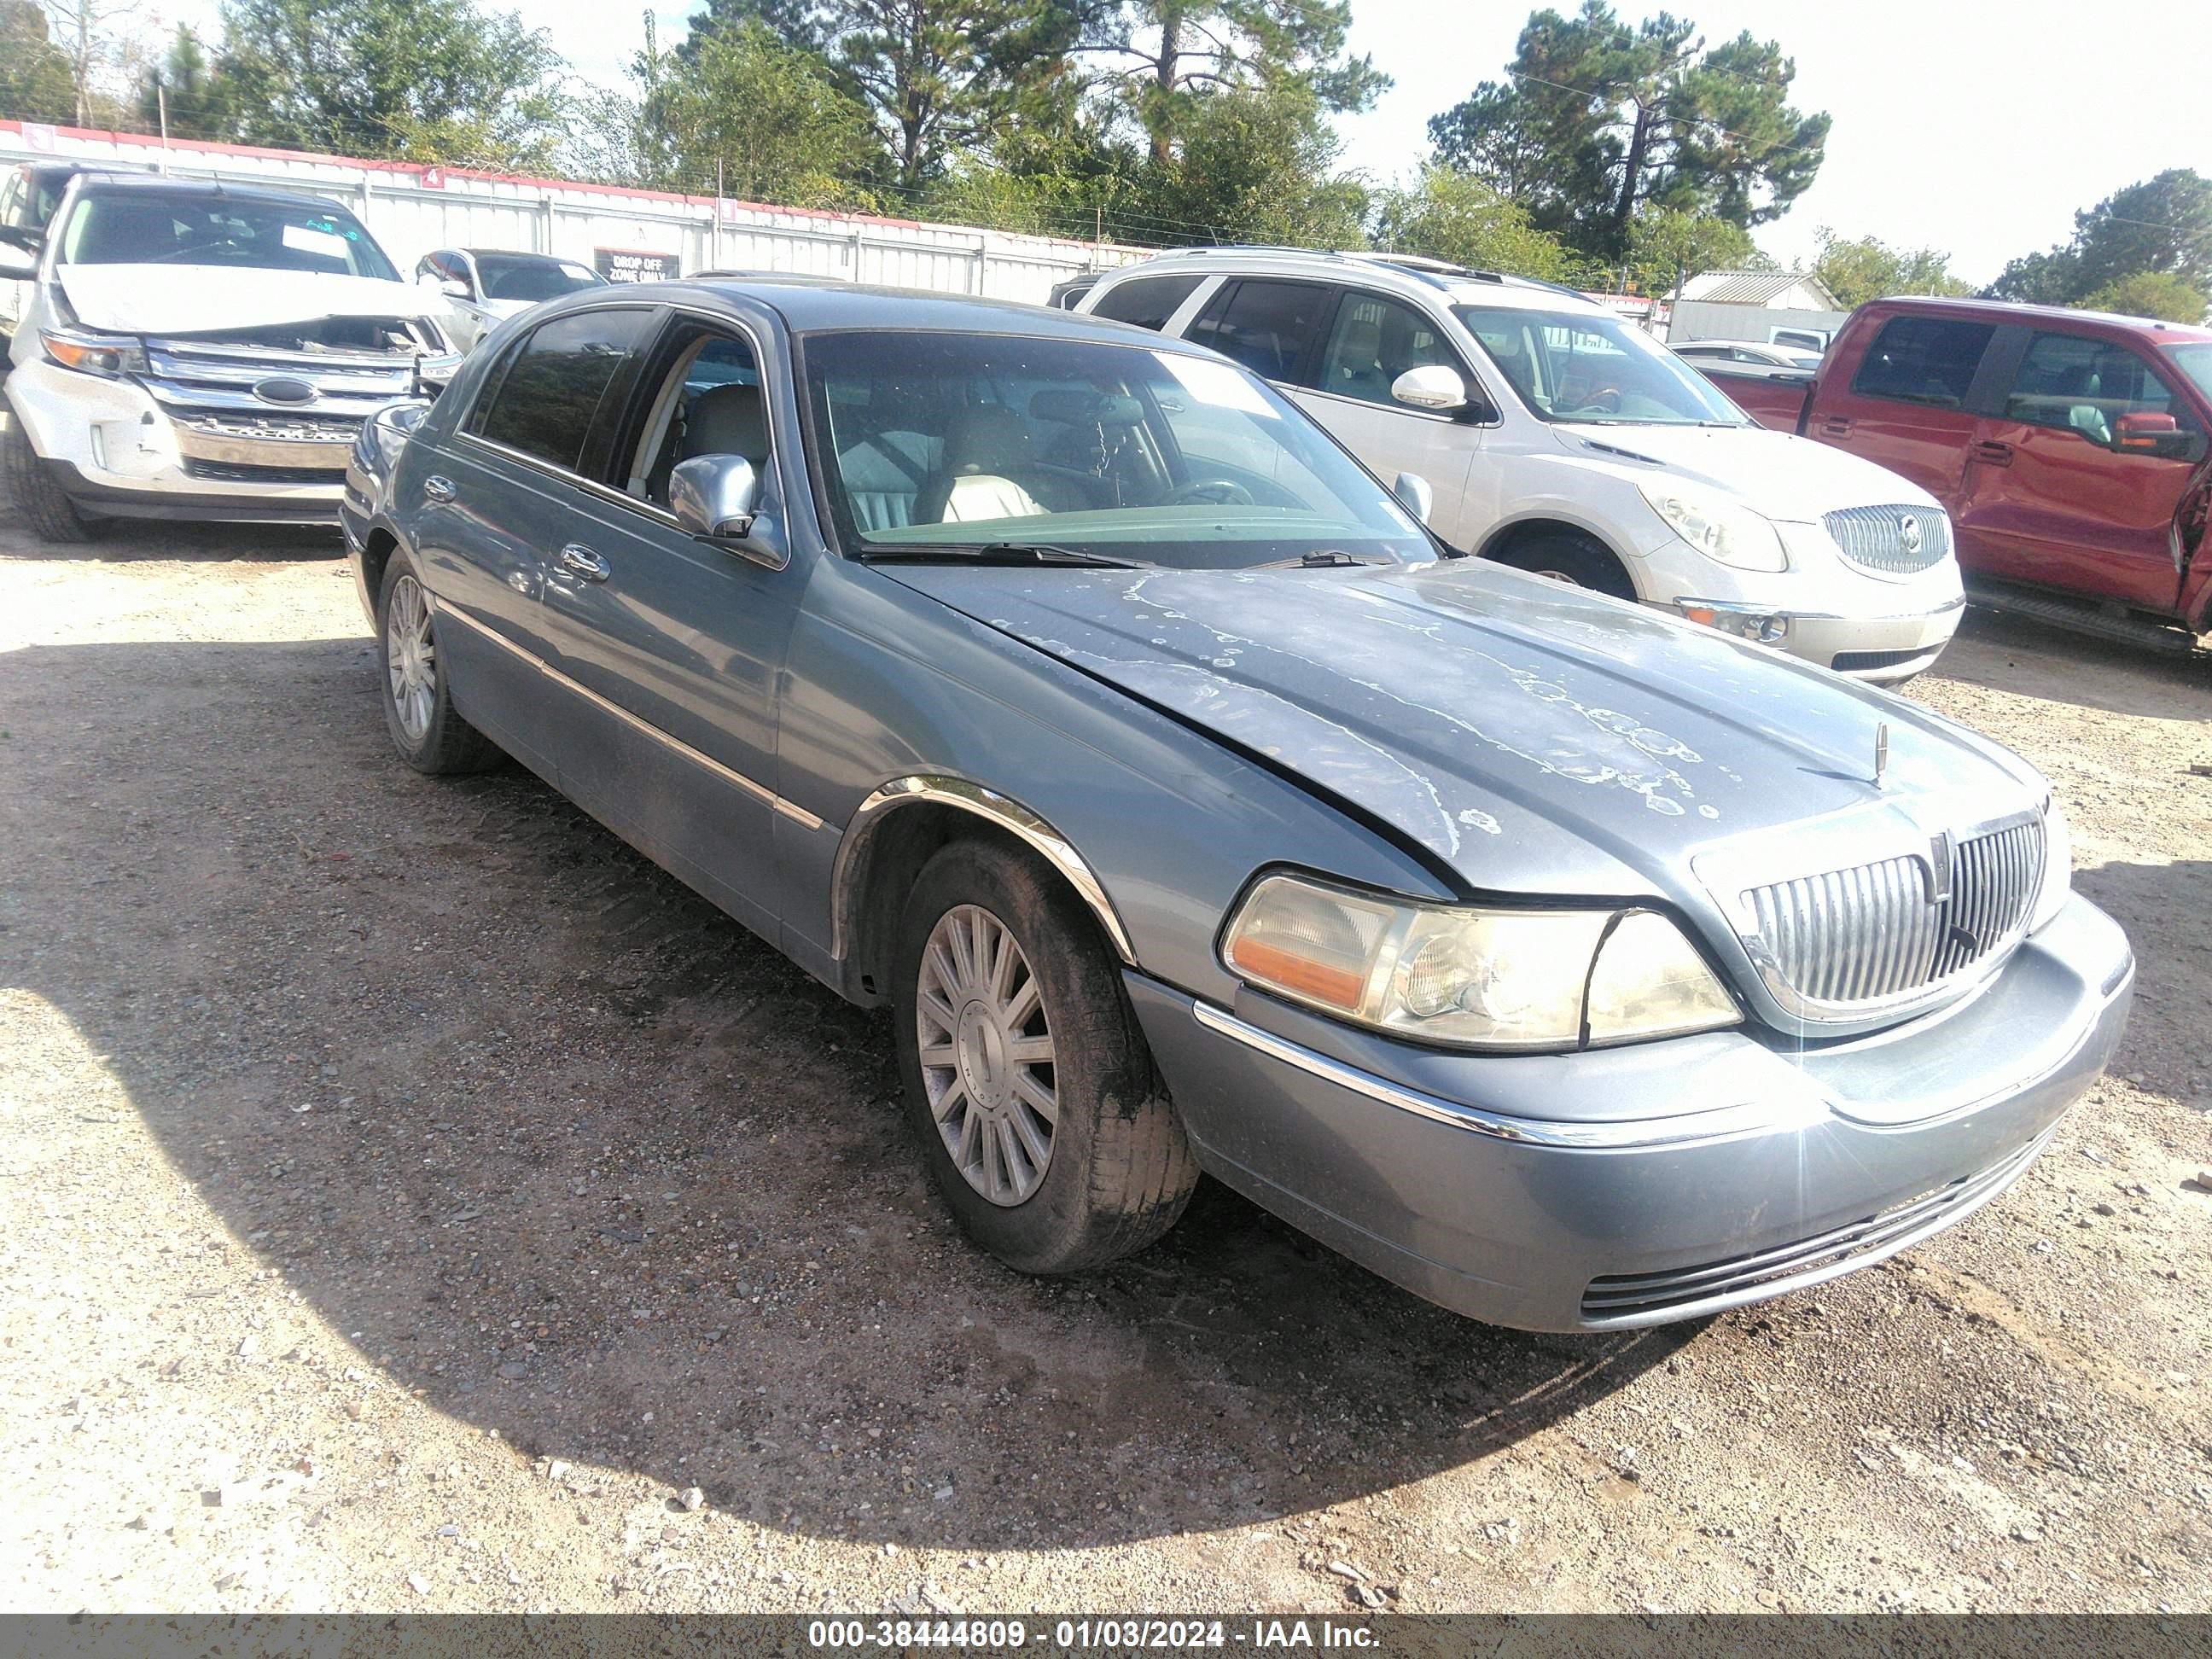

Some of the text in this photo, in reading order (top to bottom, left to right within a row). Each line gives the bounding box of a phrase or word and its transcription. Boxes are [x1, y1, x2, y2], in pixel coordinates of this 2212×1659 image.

[427, 168, 438, 185] 4
[613, 255, 663, 271] DROP OFF
[609, 268, 666, 282] ZONE ONLY
